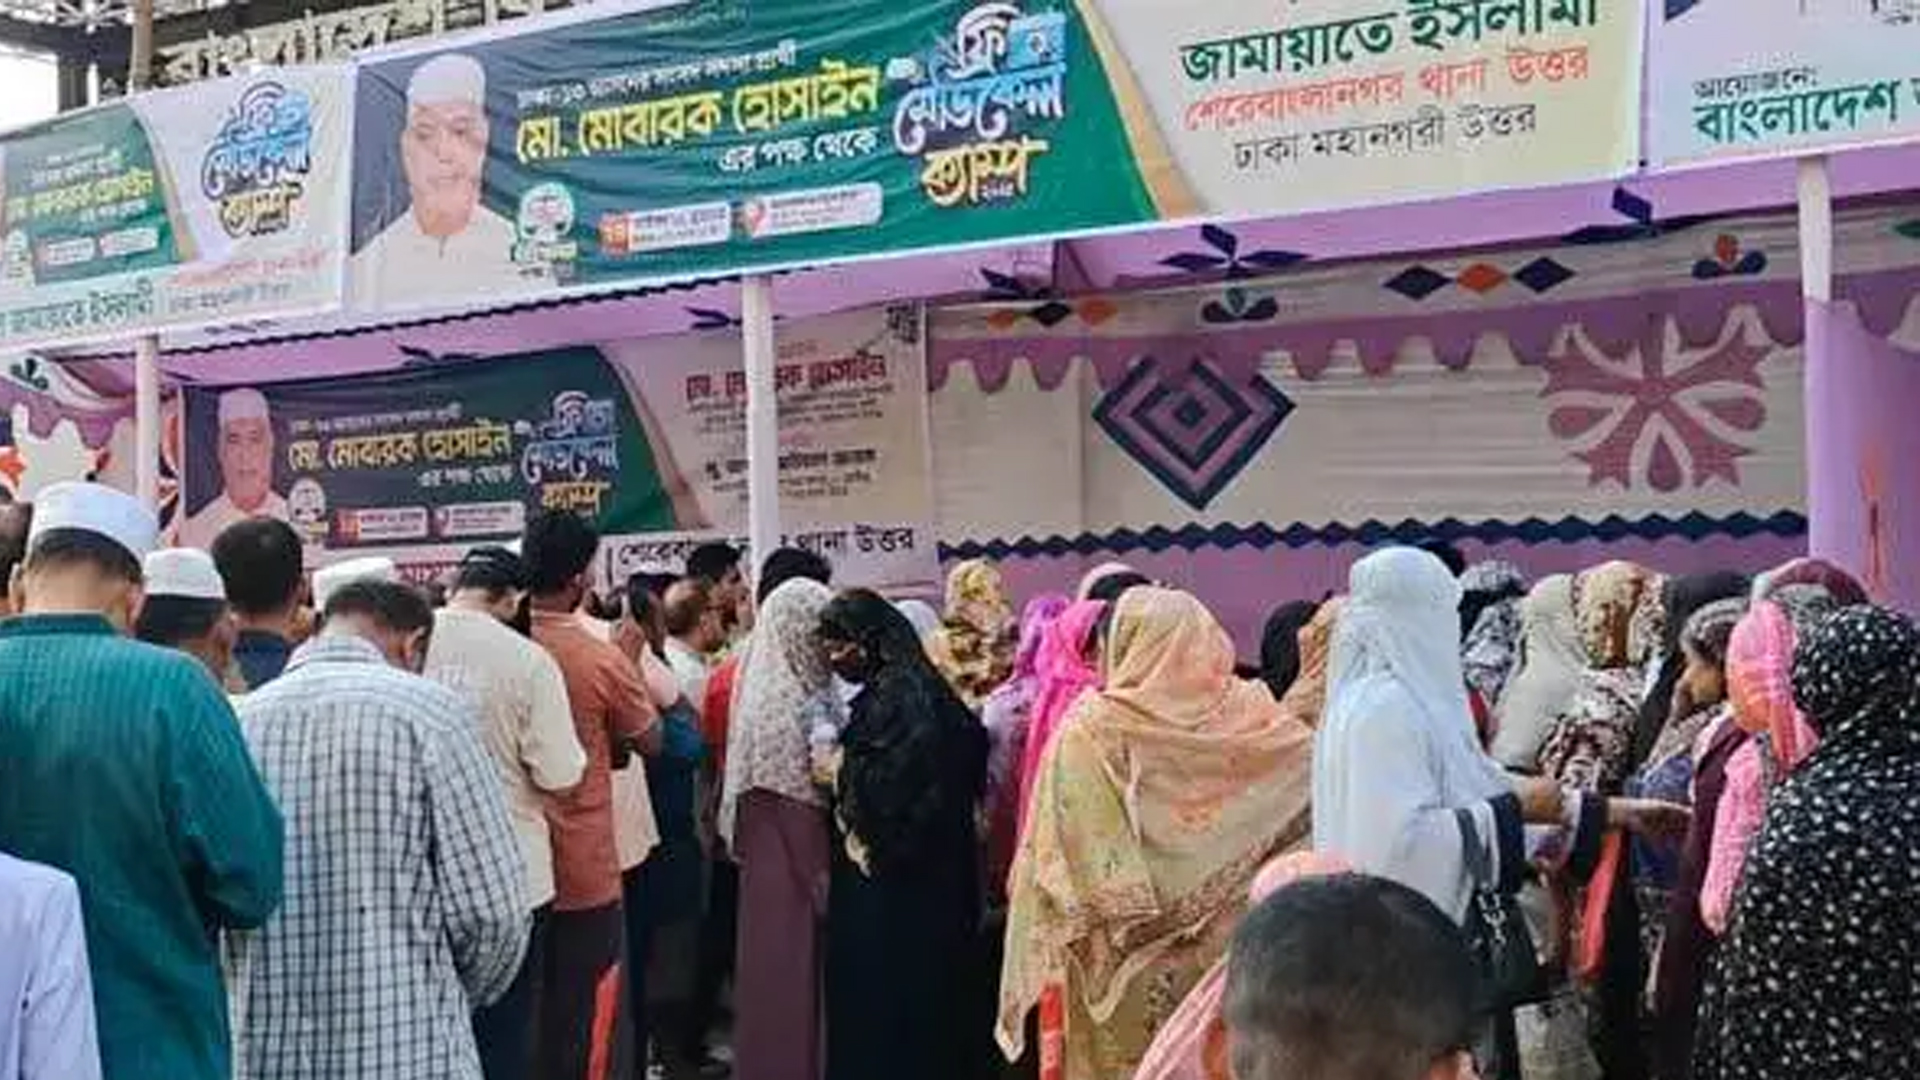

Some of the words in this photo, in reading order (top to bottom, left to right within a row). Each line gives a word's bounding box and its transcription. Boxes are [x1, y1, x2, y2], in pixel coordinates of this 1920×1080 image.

[1179, 11, 1398, 83] জামায়াতে
[516, 115, 568, 164] মো.
[578, 91, 723, 155] মোবারক
[732, 56, 881, 134] হোসাইন
[1184, 71, 1406, 131] শেরেবাংলানগর
[1419, 56, 1487, 98] থানা
[1505, 42, 1589, 84] উত্তর
[1692, 77, 1903, 143] বাংলাদেশ
[718, 145, 757, 173] এর
[761, 136, 808, 166] পক্ষ
[813, 126, 881, 161] থেকে
[921, 134, 1049, 206] ক্যাম্প
[1235, 132, 1301, 171] ঢাকা
[1311, 104, 1446, 157] মহানগরী
[1457, 103, 1537, 137] উত্তর
[328, 431, 418, 470] মোবারক
[421, 417, 512, 460] হোসাইন
[853, 523, 915, 552] উত্তর
